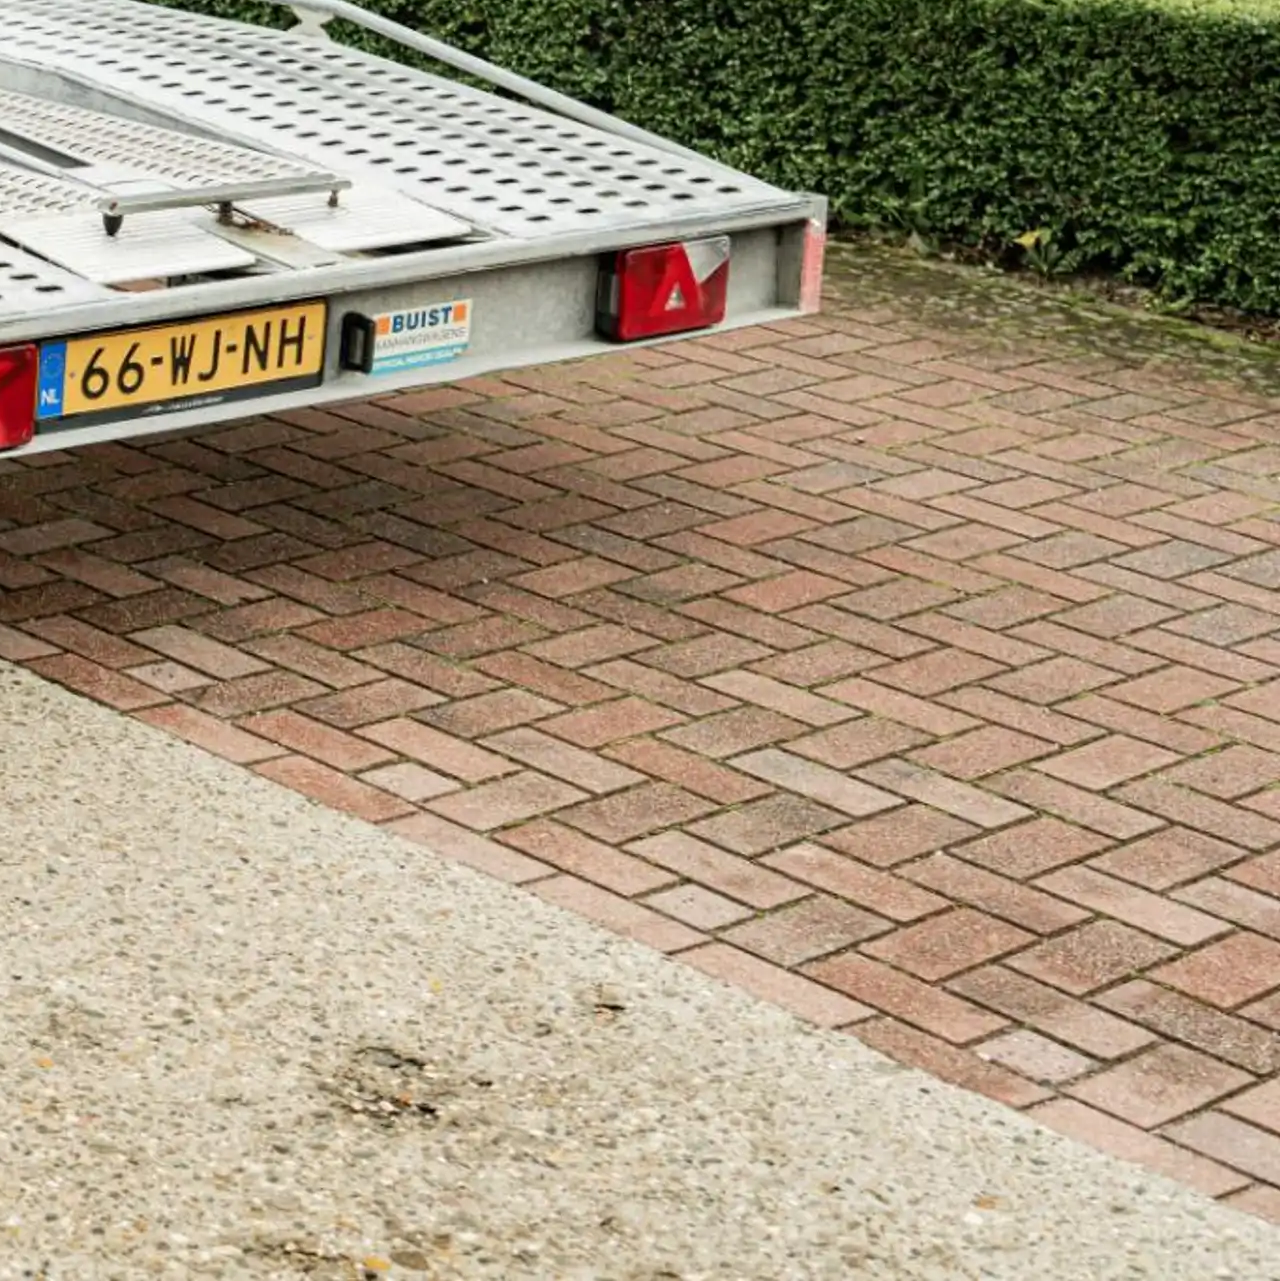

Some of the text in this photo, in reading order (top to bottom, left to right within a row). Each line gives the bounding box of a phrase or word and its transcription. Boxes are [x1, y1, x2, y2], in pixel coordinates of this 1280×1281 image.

[391, 305, 453, 333] BUIST
[40, 315, 307, 406] NL 66-WJ-NH
